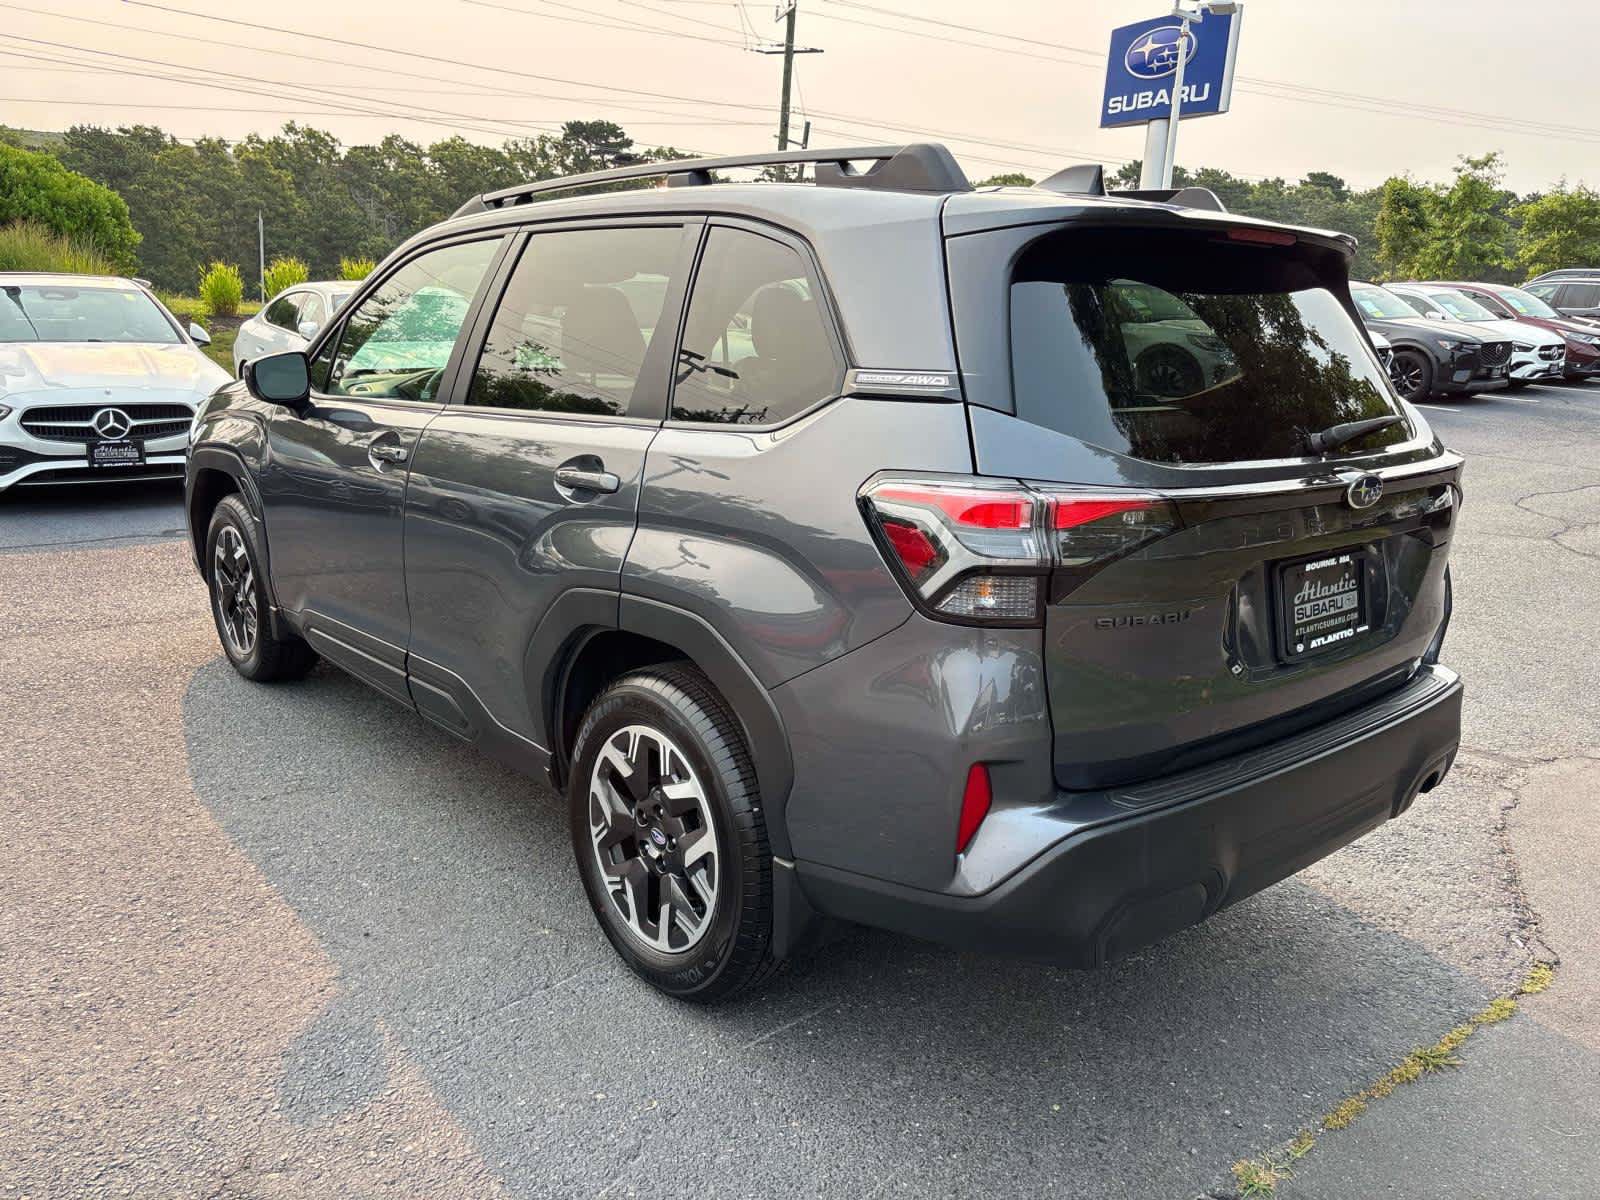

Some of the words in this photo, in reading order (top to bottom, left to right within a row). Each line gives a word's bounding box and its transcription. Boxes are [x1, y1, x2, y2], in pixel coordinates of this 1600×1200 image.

[1107, 83, 1210, 115] SUBARU
[1294, 572, 1358, 604] Atlantic
[1094, 610, 1192, 632] SUBARU
[1295, 595, 1344, 621] SUBARU
[1310, 628, 1354, 649] ATLANTIC
